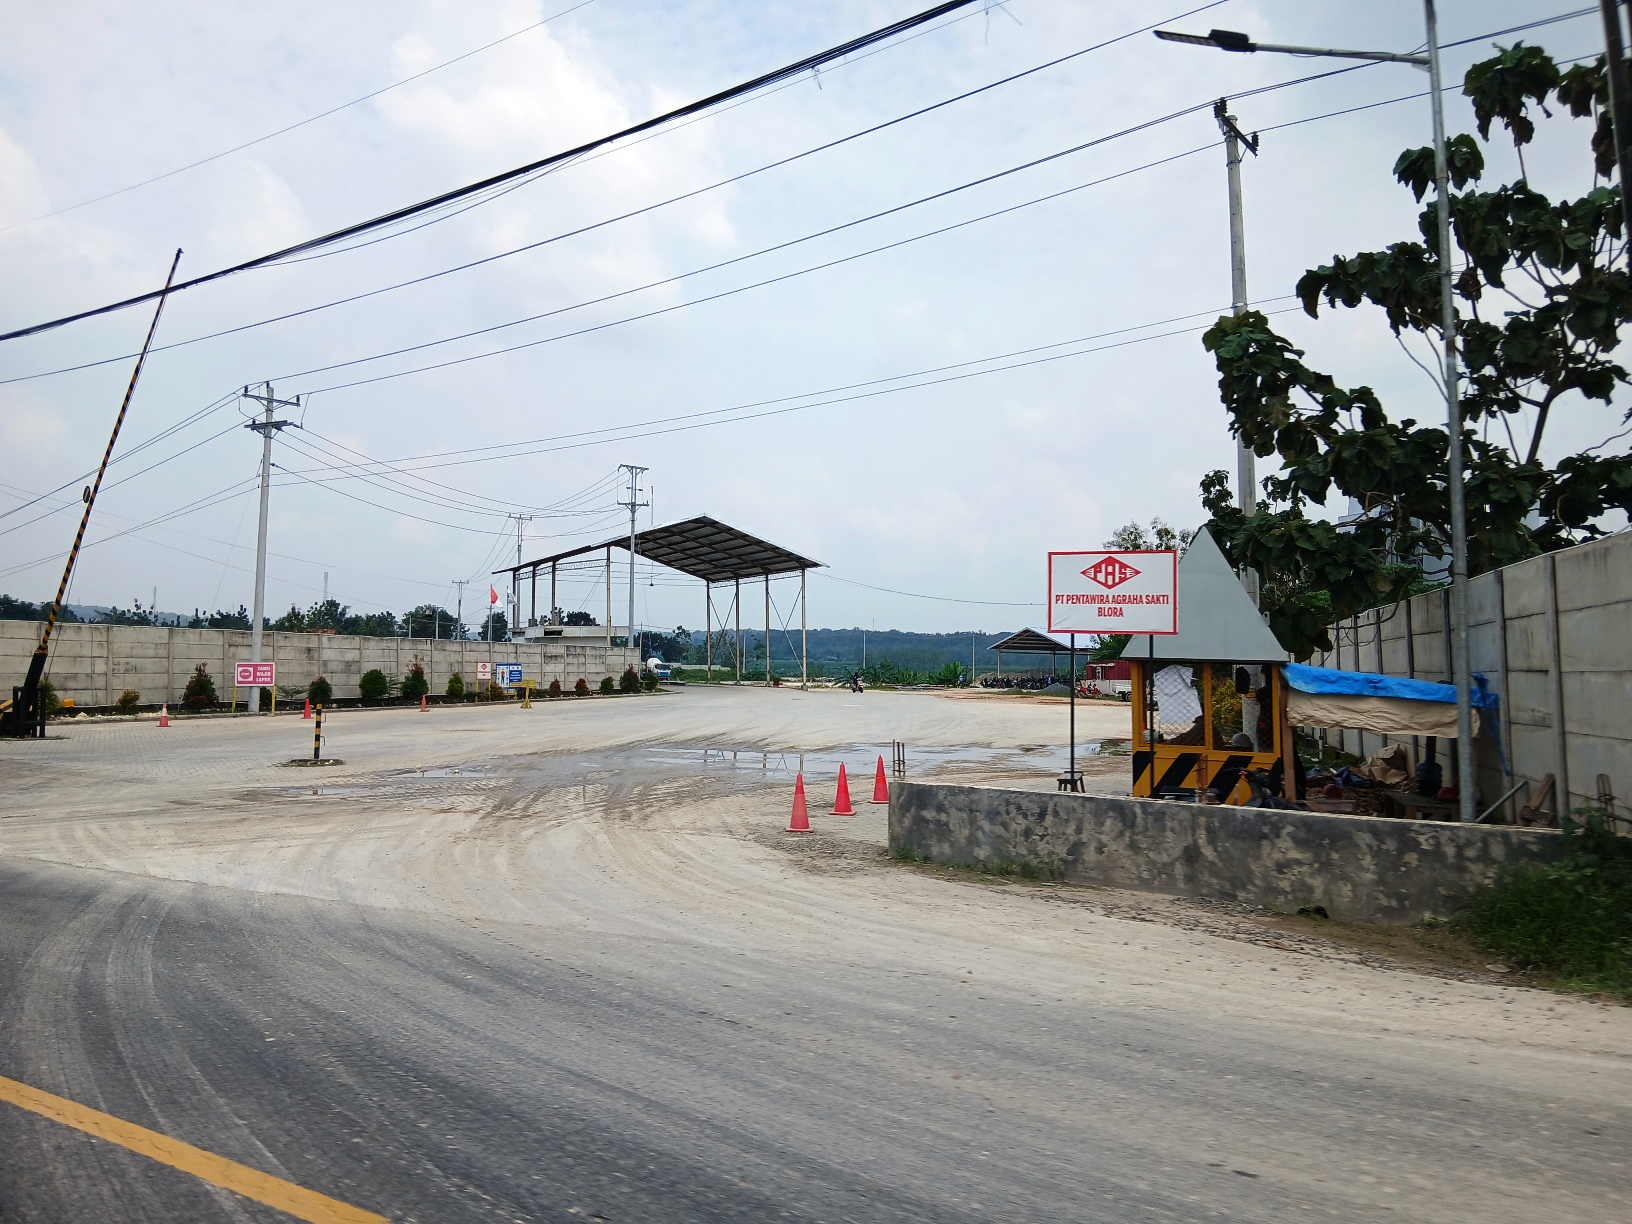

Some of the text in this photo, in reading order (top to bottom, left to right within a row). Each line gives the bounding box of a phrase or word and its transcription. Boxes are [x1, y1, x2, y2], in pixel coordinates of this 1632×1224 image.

[1055, 594, 1169, 605] PT PENTAWIRA AGRAHA SAKTI
[1097, 607, 1124, 617] BLORA
